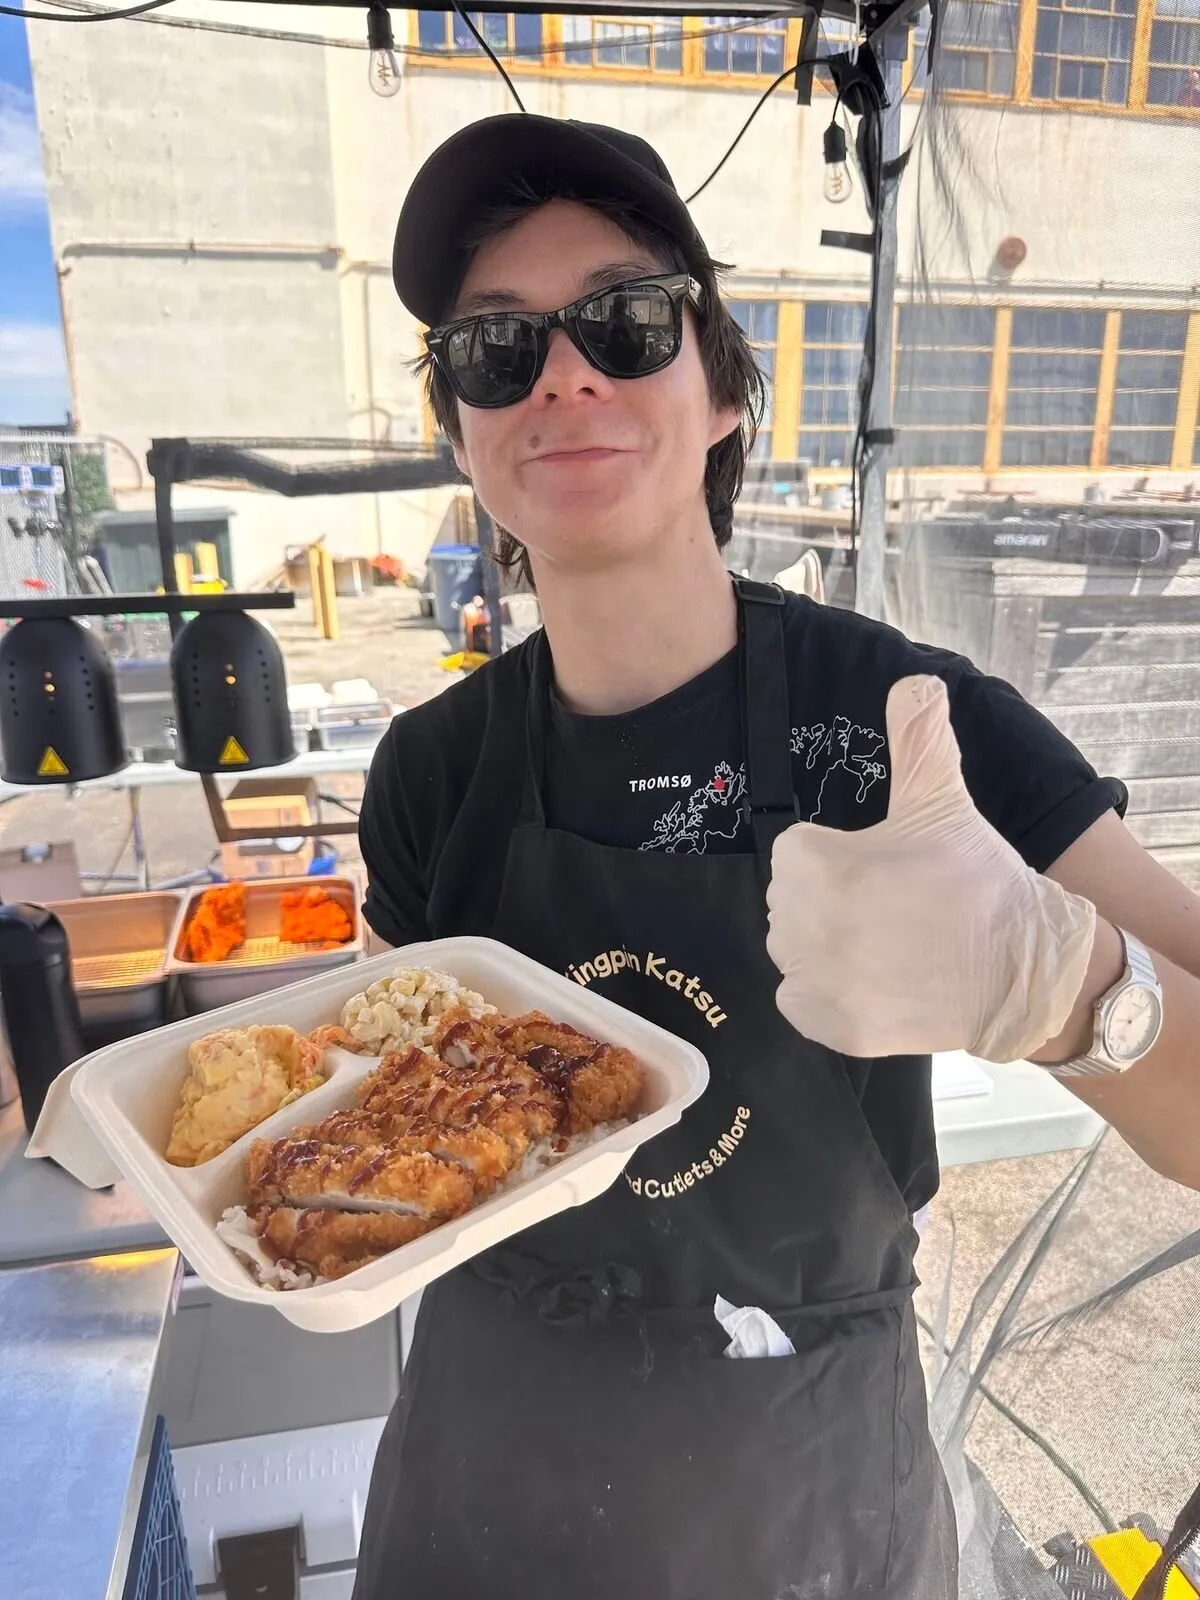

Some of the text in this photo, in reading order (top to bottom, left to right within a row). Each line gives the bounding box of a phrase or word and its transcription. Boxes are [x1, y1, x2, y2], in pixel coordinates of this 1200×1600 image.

[629, 774, 692, 793] TROMSØ
[565, 944, 728, 1029] ingpin Katsu
[717, 1106, 751, 1156] More
[709, 1148, 727, 1167] &
[644, 1159, 714, 1199] Cutlets
